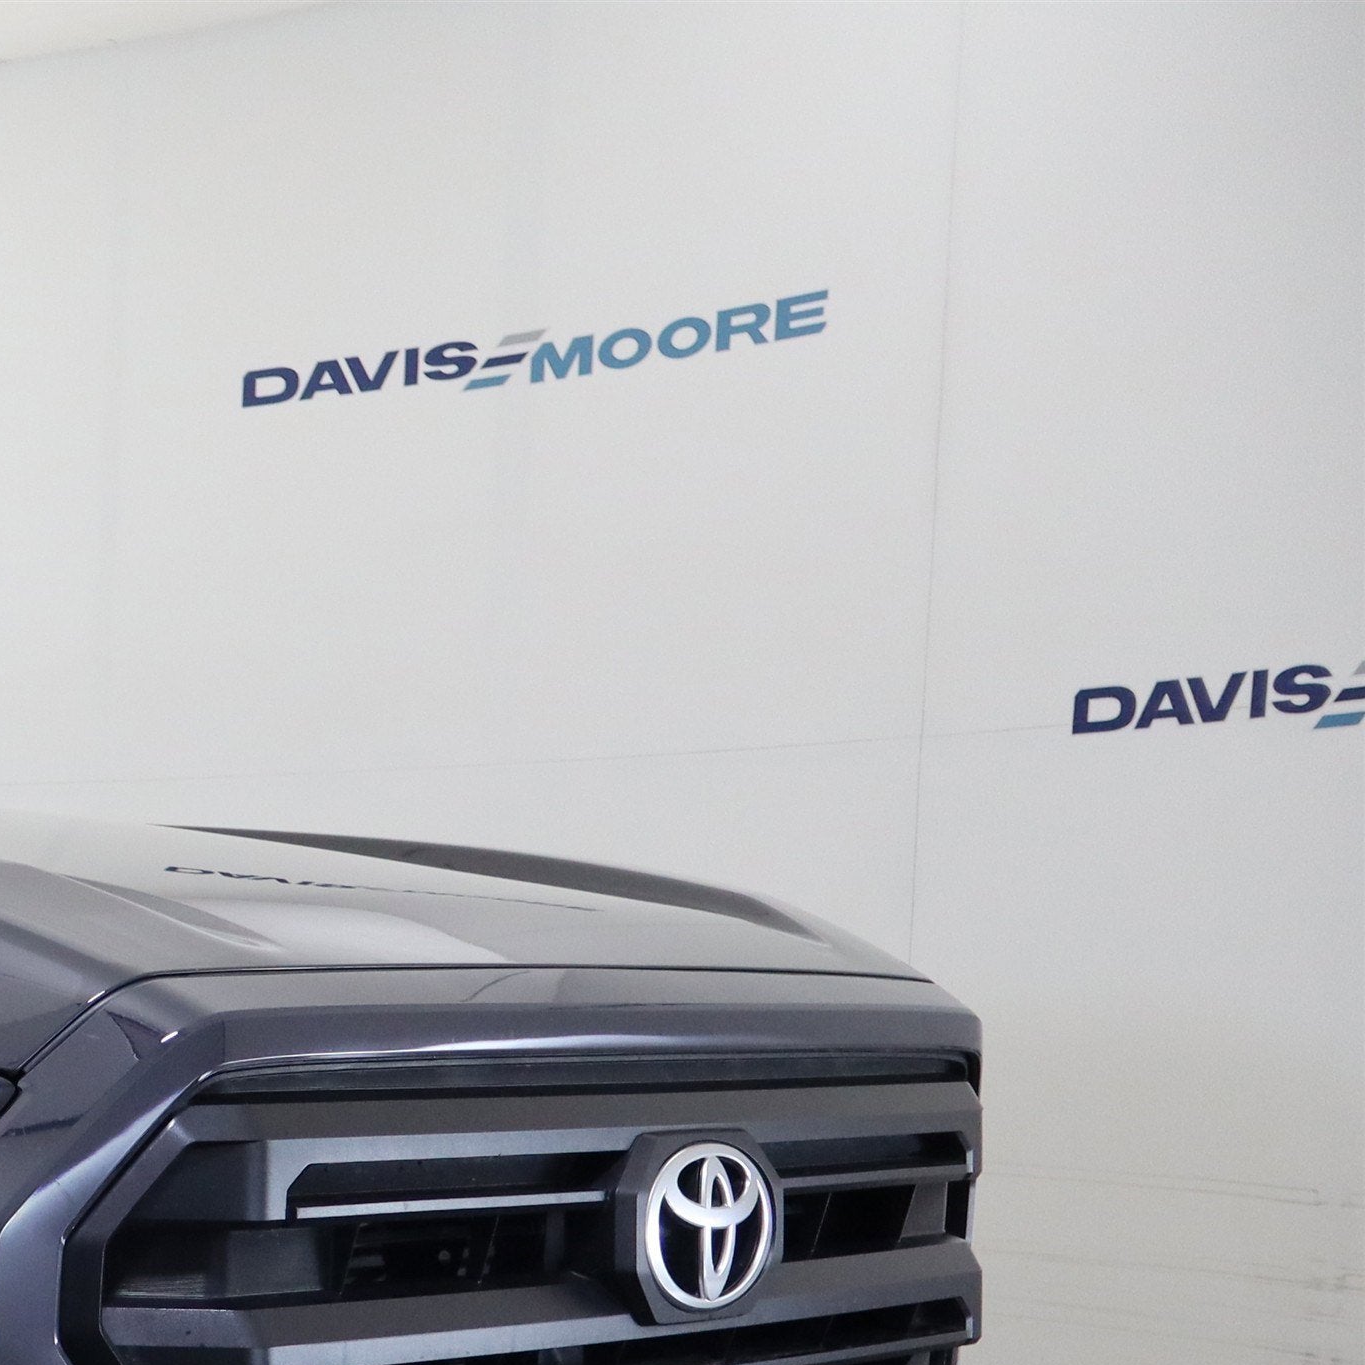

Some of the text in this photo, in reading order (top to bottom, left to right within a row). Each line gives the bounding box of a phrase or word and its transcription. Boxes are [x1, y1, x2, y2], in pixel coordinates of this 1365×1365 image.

[242, 289, 829, 408] DAVIS MOORE
[1072, 664, 1333, 735] DAVIS
